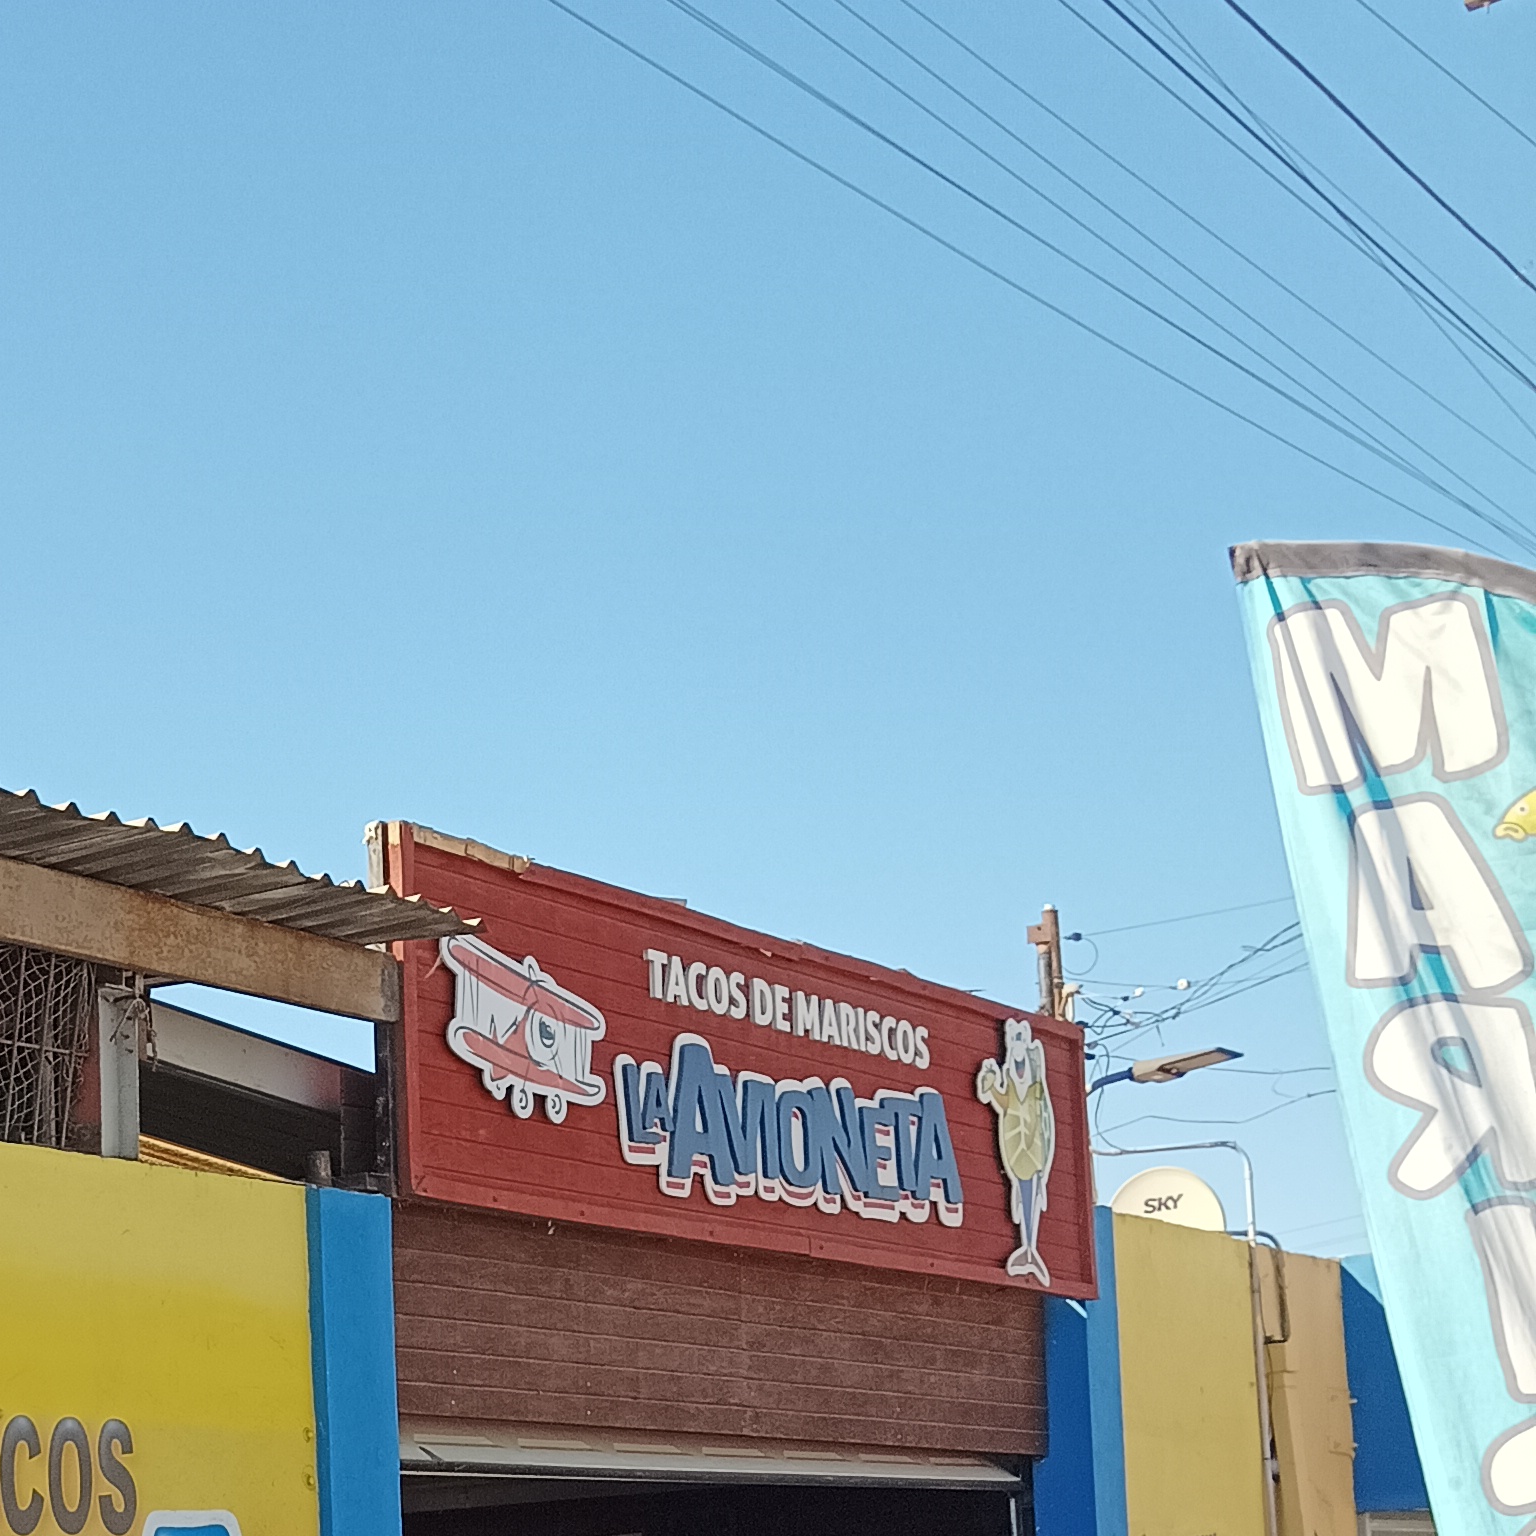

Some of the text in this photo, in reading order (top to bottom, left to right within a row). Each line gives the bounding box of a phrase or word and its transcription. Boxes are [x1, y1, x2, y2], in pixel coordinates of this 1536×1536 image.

[644, 948, 930, 1069] TACOS DE MARISCOS
[613, 1033, 963, 1227] LA AVIONETA
[1144, 1193, 1183, 1214] SKY
